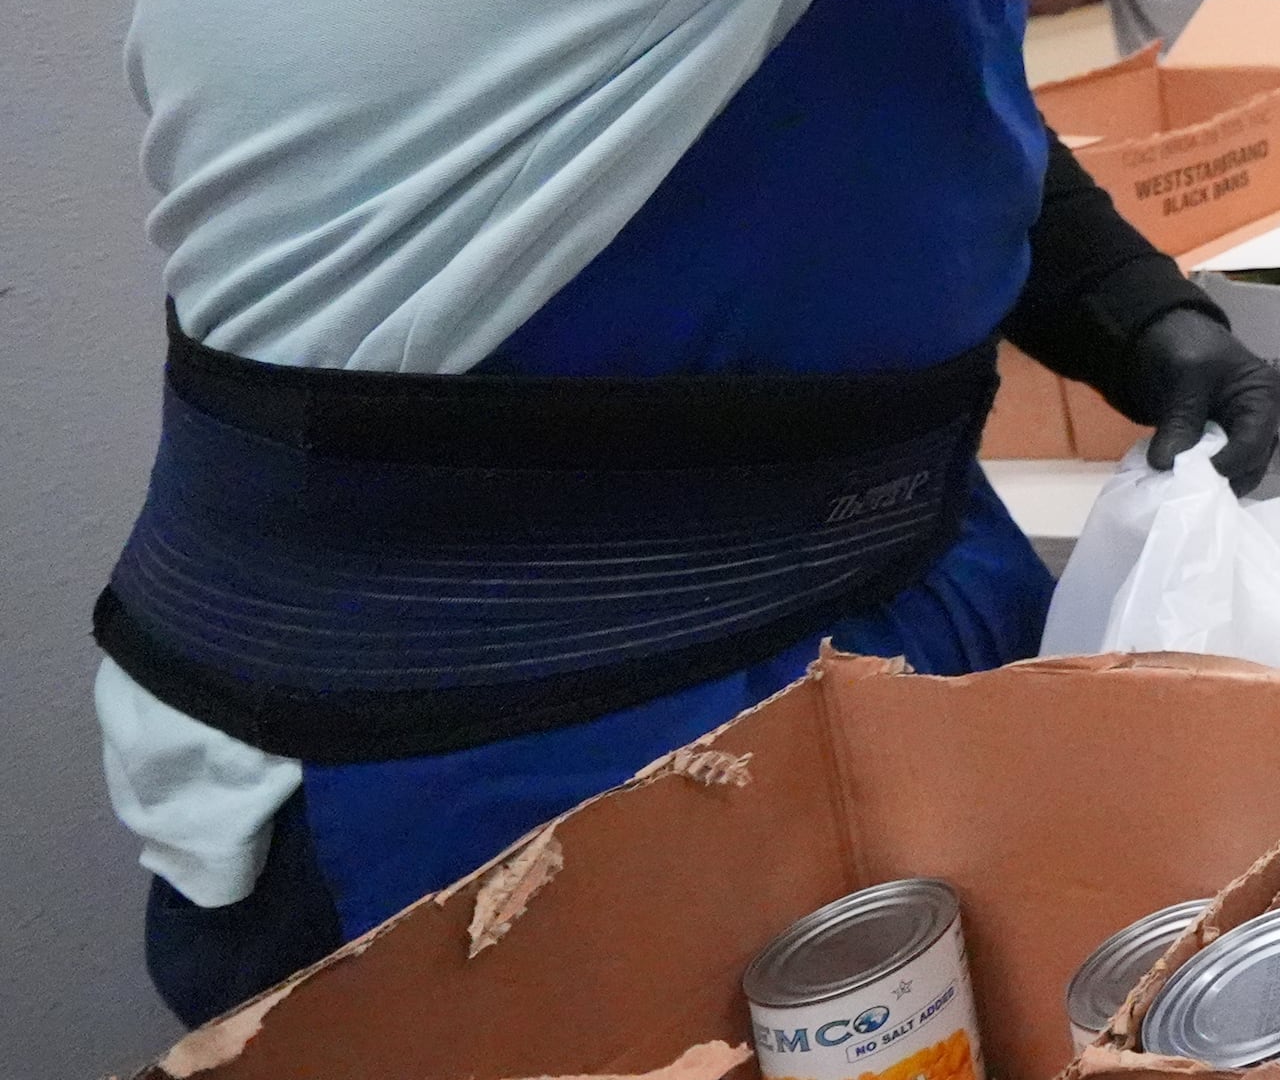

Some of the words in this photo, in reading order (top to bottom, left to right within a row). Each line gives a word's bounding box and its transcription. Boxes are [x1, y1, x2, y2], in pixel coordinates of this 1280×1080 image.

[855, 1041, 877, 1057] NO
[882, 1021, 915, 1045] SALT
[919, 986, 955, 1024] ADDED
